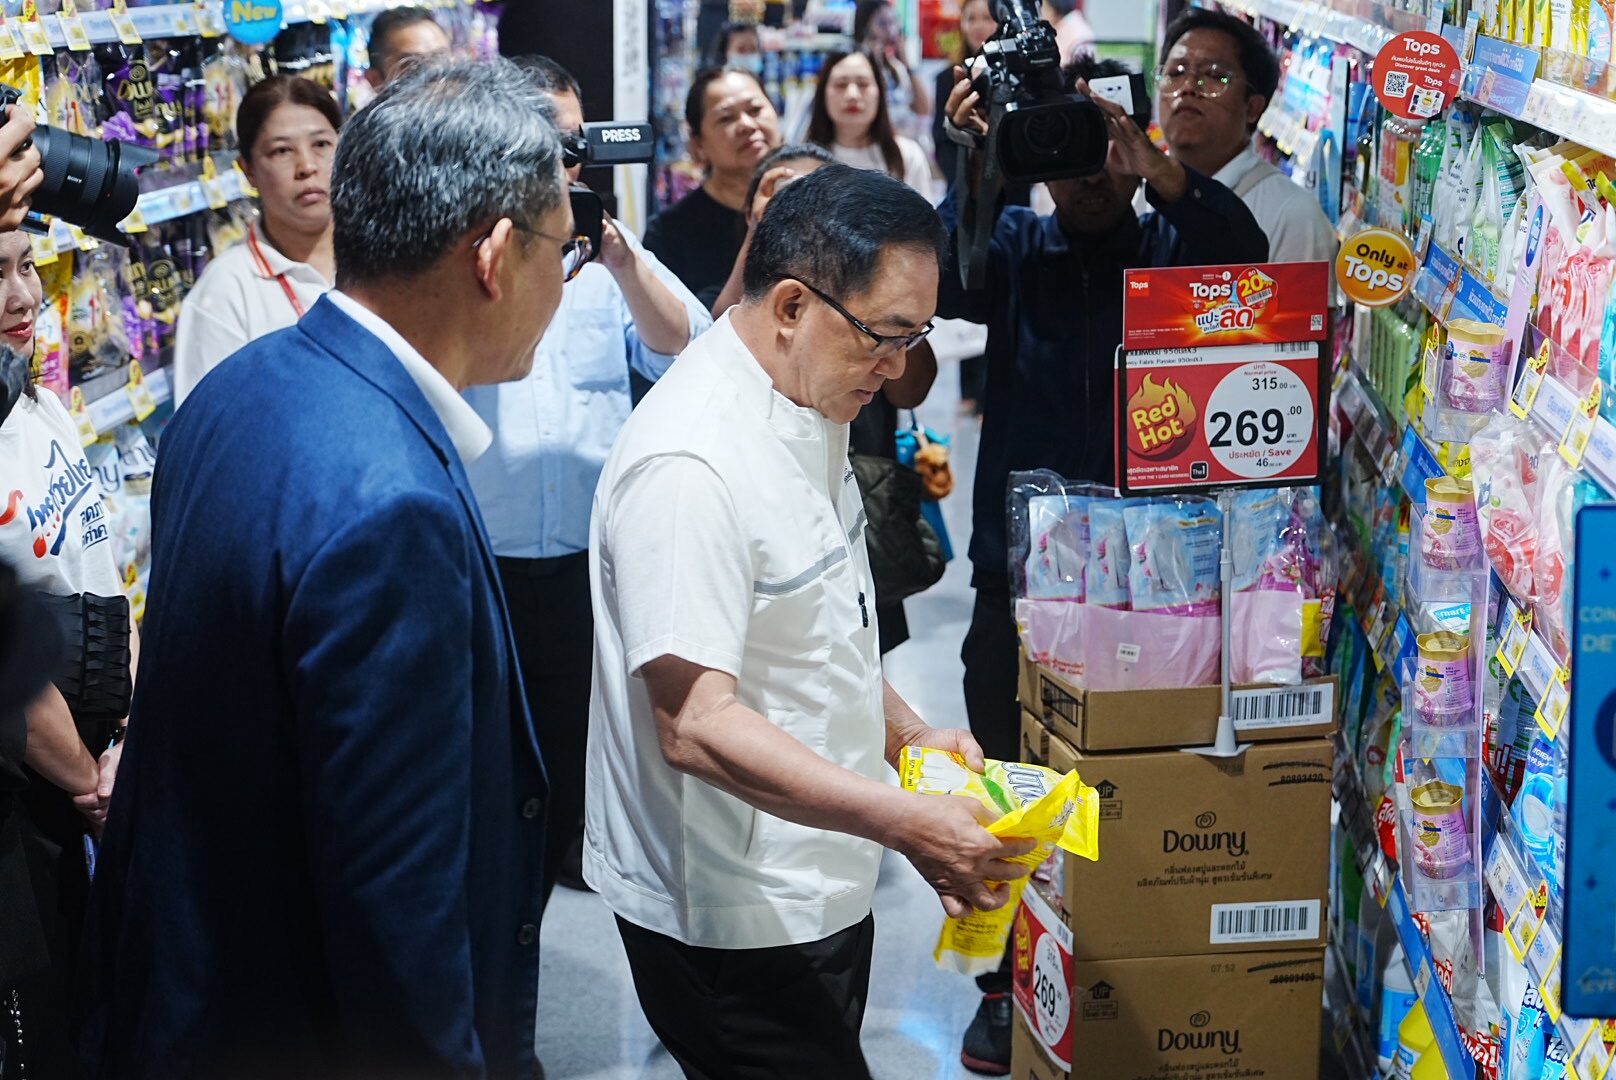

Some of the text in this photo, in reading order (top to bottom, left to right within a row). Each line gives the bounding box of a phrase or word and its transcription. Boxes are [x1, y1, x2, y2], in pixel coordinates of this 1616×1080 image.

[232, 0, 277, 23] New
[1403, 37, 1441, 56] Tops
[1394, 62, 1415, 70] Discover
[1424, 75, 1444, 87] Tops
[601, 127, 641, 143] PRESS
[1356, 243, 1396, 269] Only
[1397, 260, 1409, 271] at
[1344, 255, 1404, 293] Tops
[1130, 281, 1149, 290] Tops
[1189, 282, 1231, 300] Tops
[1198, 308, 1254, 329] แปะ ลด
[1132, 395, 1177, 429] Red
[1138, 420, 1184, 451] Hot
[1209, 408, 1285, 448] 269
[1229, 449, 1261, 460] ประหยัด
[1268, 448, 1292, 457] Save
[1163, 829, 1246, 856] Downy
[1033, 964, 1056, 1017] 269
[1094, 986, 1109, 998] UP
[1158, 1028, 1239, 1053] Downy
